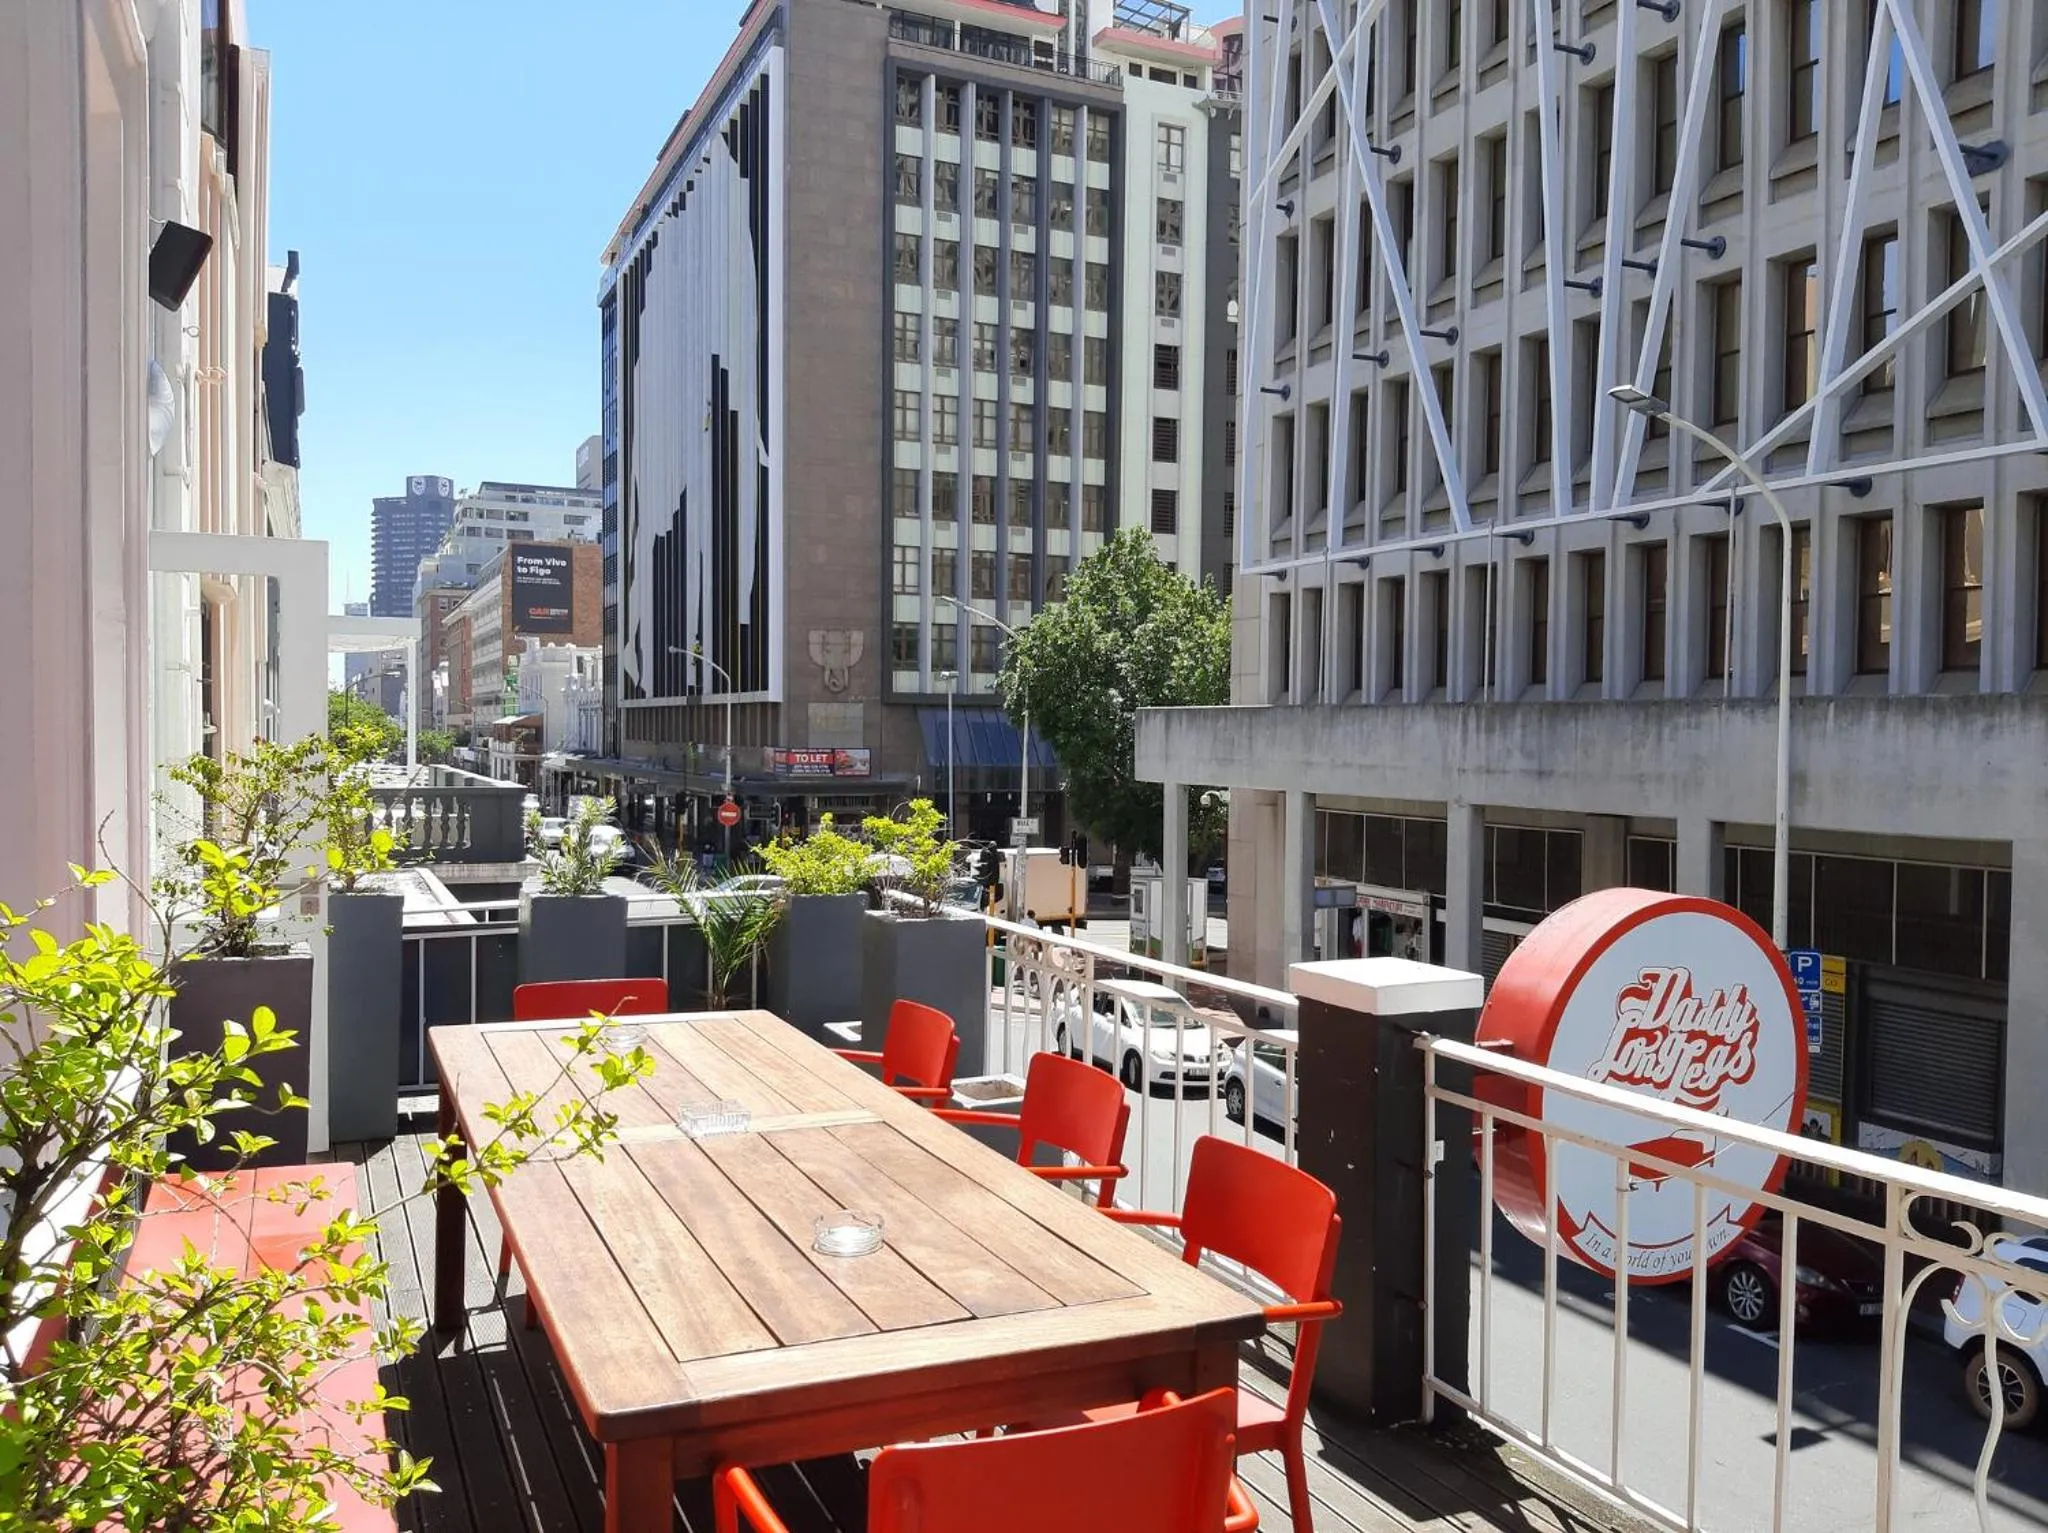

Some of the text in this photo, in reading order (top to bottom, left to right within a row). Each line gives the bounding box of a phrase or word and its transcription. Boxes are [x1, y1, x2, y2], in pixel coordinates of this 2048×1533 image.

[517, 556, 568, 567] From Vivo
[517, 566, 552, 576] to Figo
[795, 753, 809, 763] TO
[810, 753, 829, 763] LET
[1797, 956, 1813, 973] P
[1617, 966, 1760, 1044] Daddy
[1586, 1009, 1688, 1086] Long
[1585, 1233, 1601, 1252] In
[1601, 1247, 1612, 1259] a
[1613, 1250, 1650, 1269] orld
[1652, 1248, 1670, 1274] of
[1668, 1248, 1694, 1272] you
